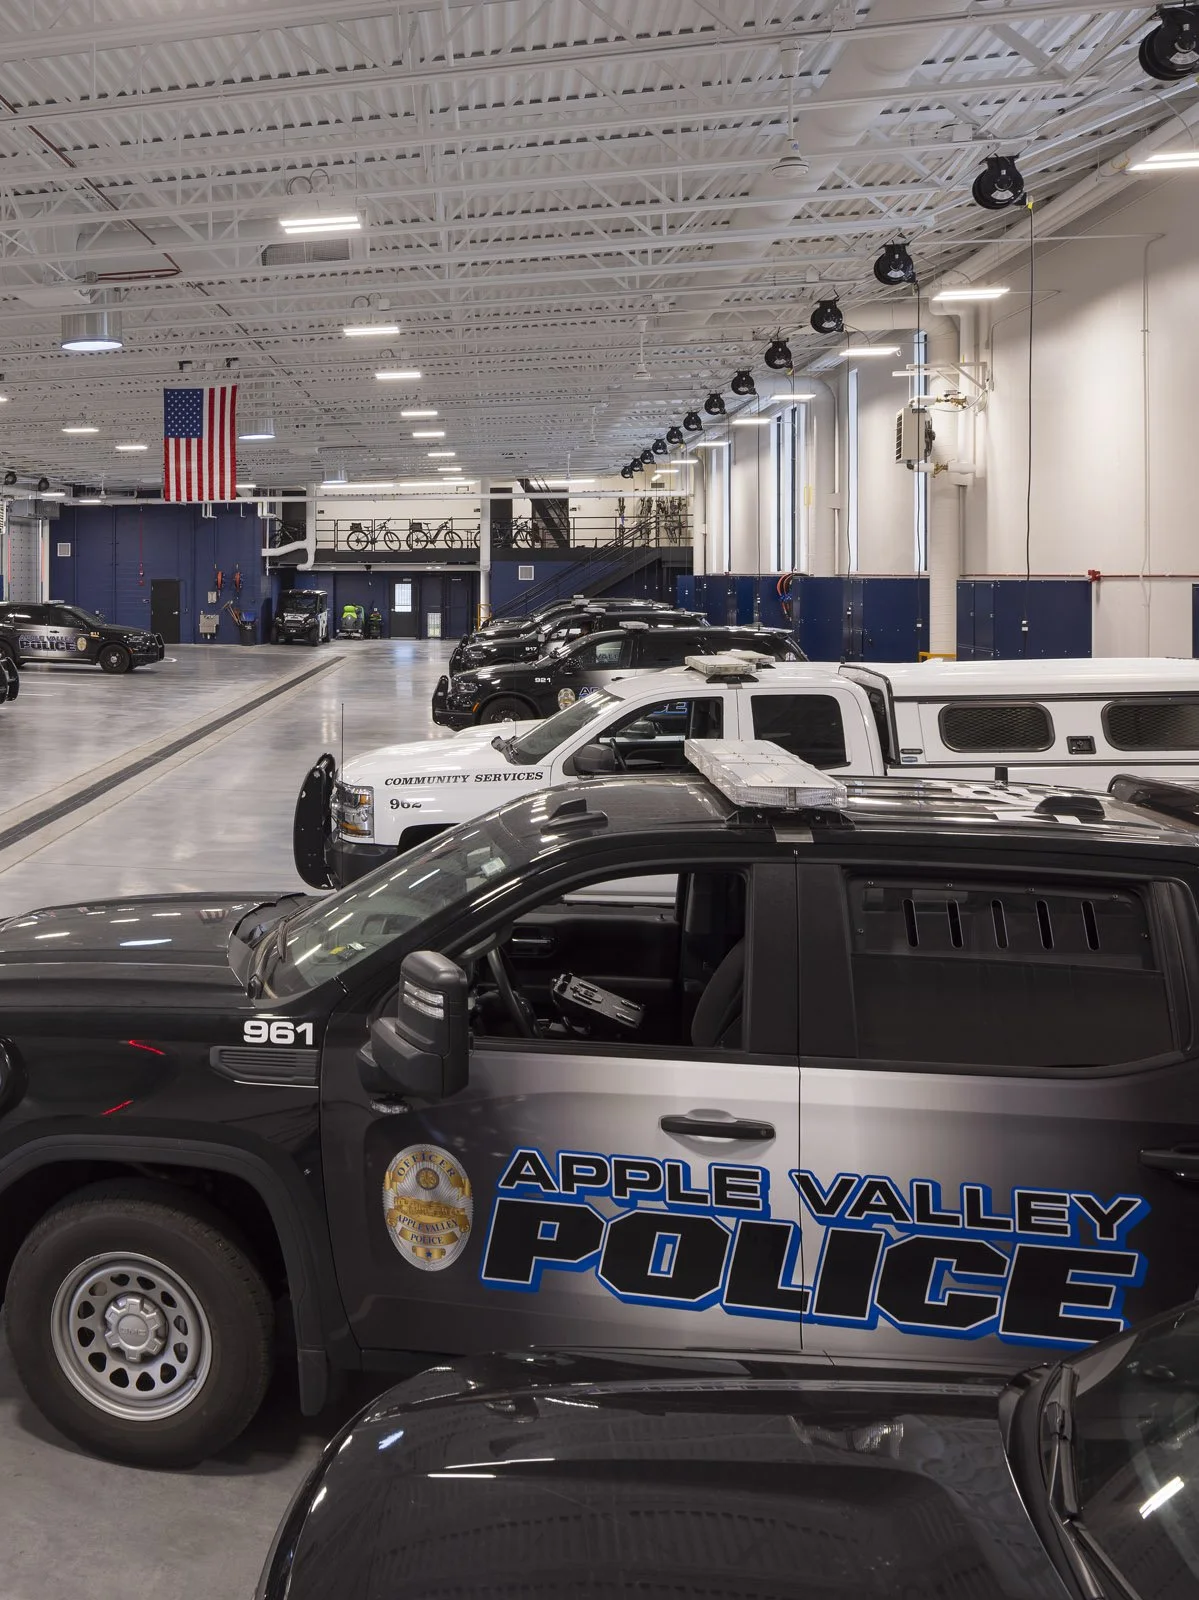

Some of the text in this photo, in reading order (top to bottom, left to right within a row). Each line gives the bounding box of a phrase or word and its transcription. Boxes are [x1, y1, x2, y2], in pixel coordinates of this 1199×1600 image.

[19, 640, 77, 652] POLICE
[384, 772, 544, 786] COMMUNITY SERVICES
[389, 798, 422, 810] 962
[243, 1020, 314, 1045] 961
[397, 1151, 456, 1177] OFFICER
[497, 1148, 1147, 1243] APPLE VALLEY
[396, 1214, 459, 1232] APPLE VALLEY
[410, 1234, 443, 1244] POLICE
[480, 1196, 1147, 1350] POLICE
